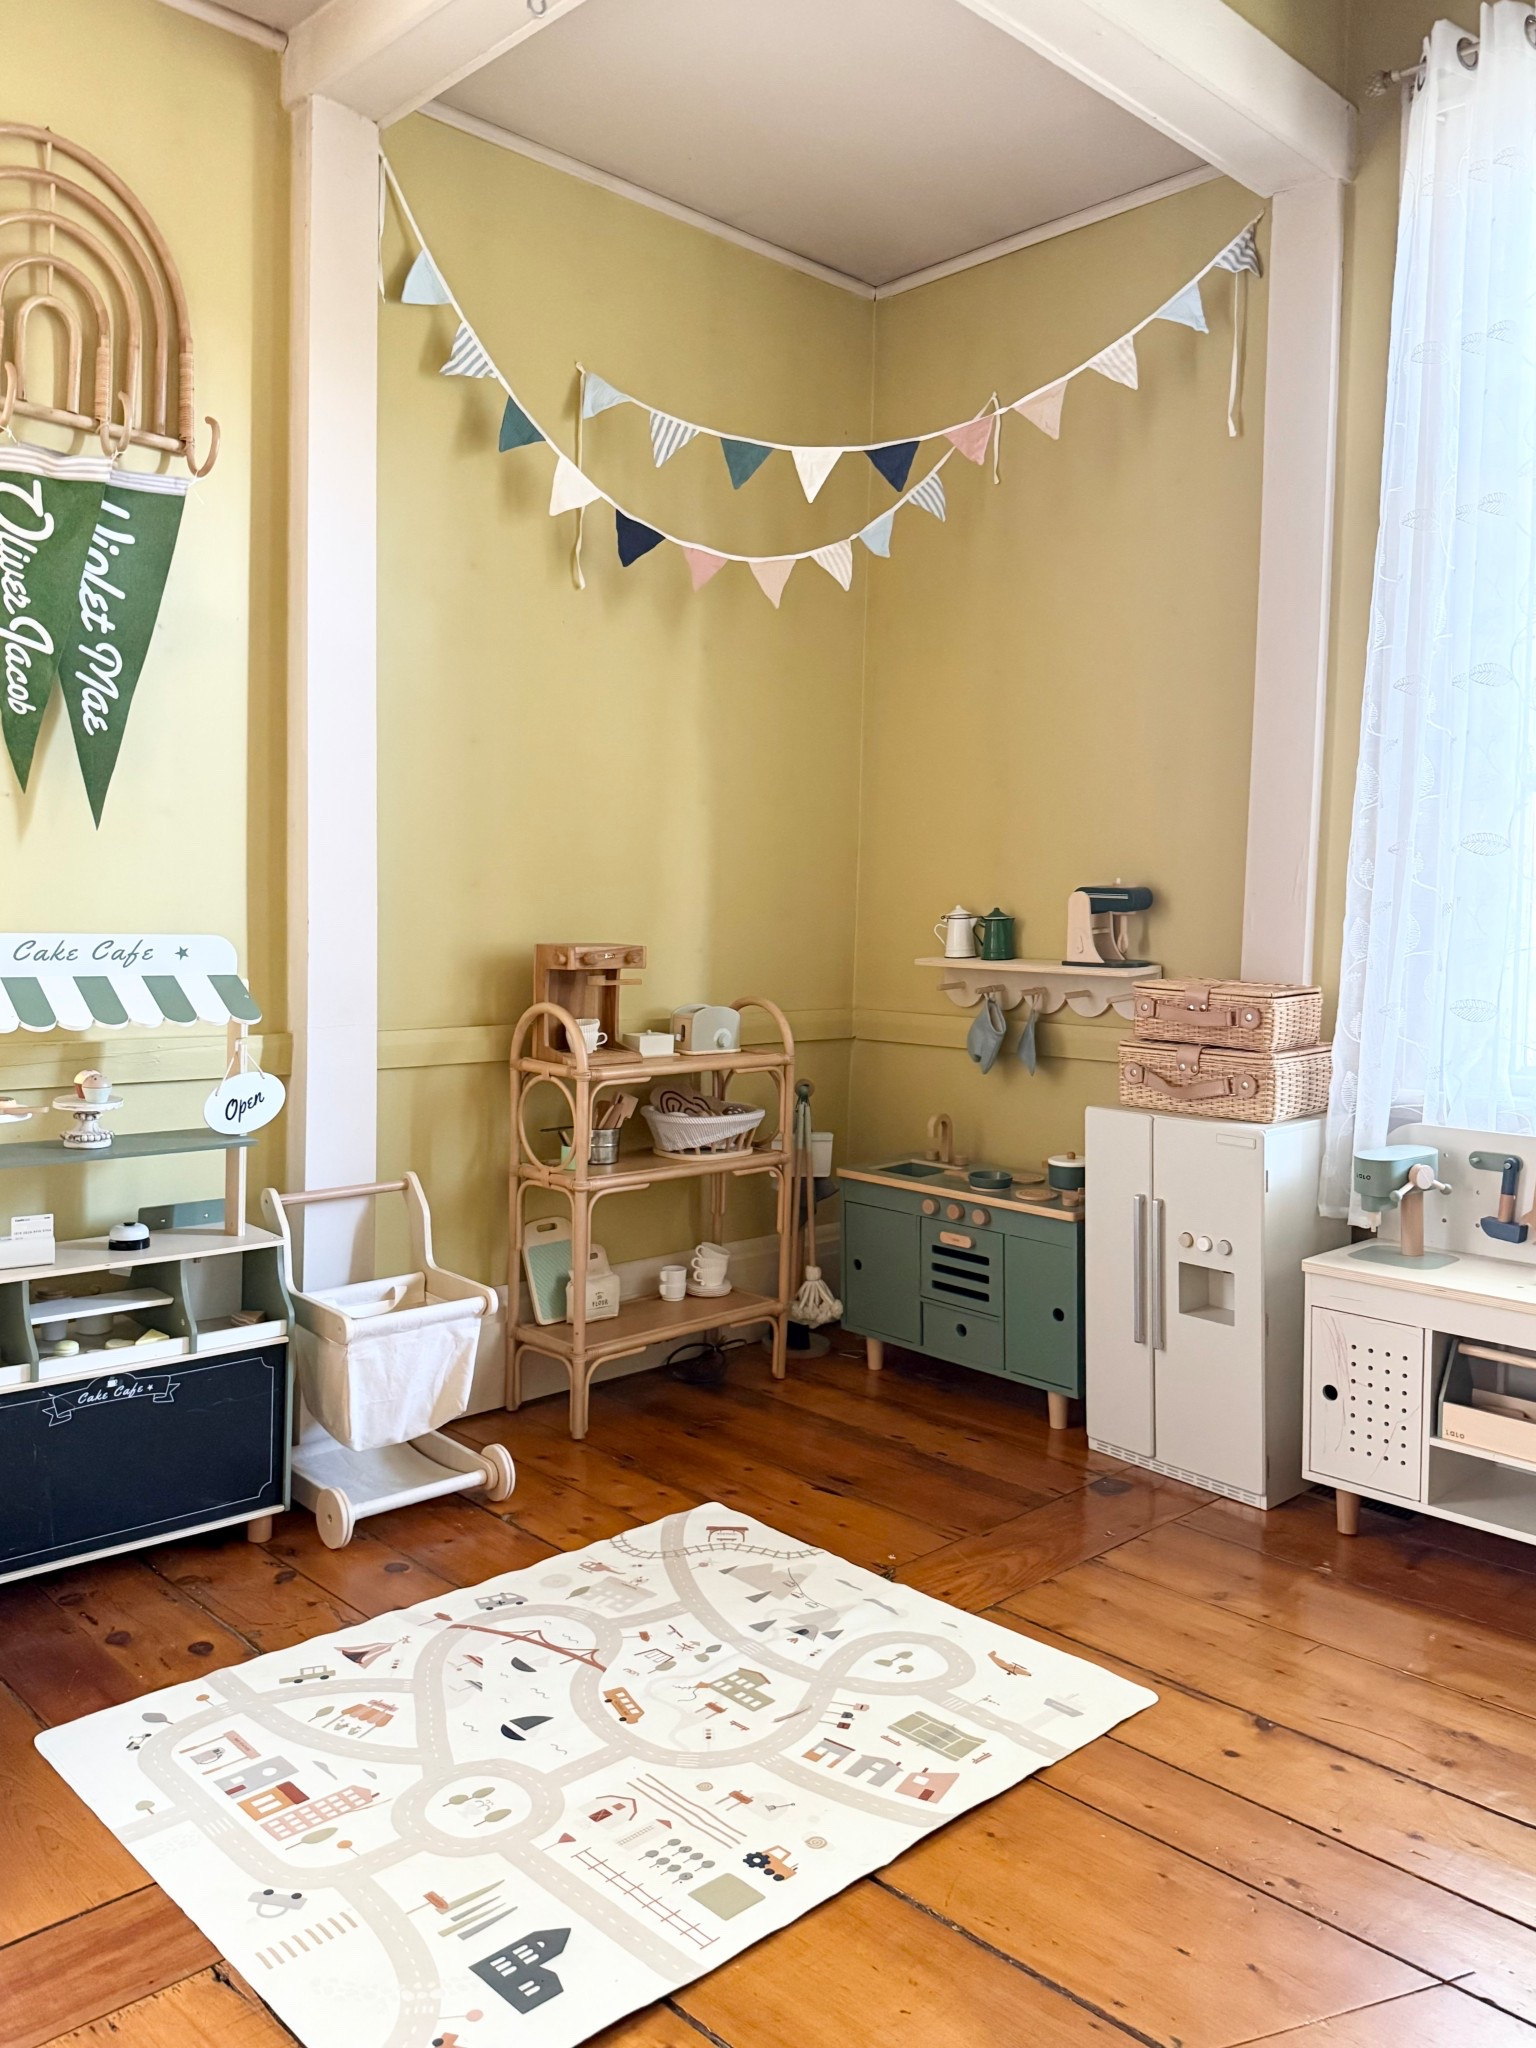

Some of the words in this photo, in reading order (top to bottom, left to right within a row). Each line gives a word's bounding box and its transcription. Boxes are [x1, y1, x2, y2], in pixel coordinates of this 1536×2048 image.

[0, 479, 55, 615] Oliver
[0, 616, 55, 716] Jacob
[75, 642, 123, 737] Mae
[12, 939, 79, 962] Cake
[91, 938, 154, 968] Cafe
[225, 1091, 265, 1123] Open
[77, 1388, 108, 1404] Cake
[113, 1382, 144, 1397] Cafe
